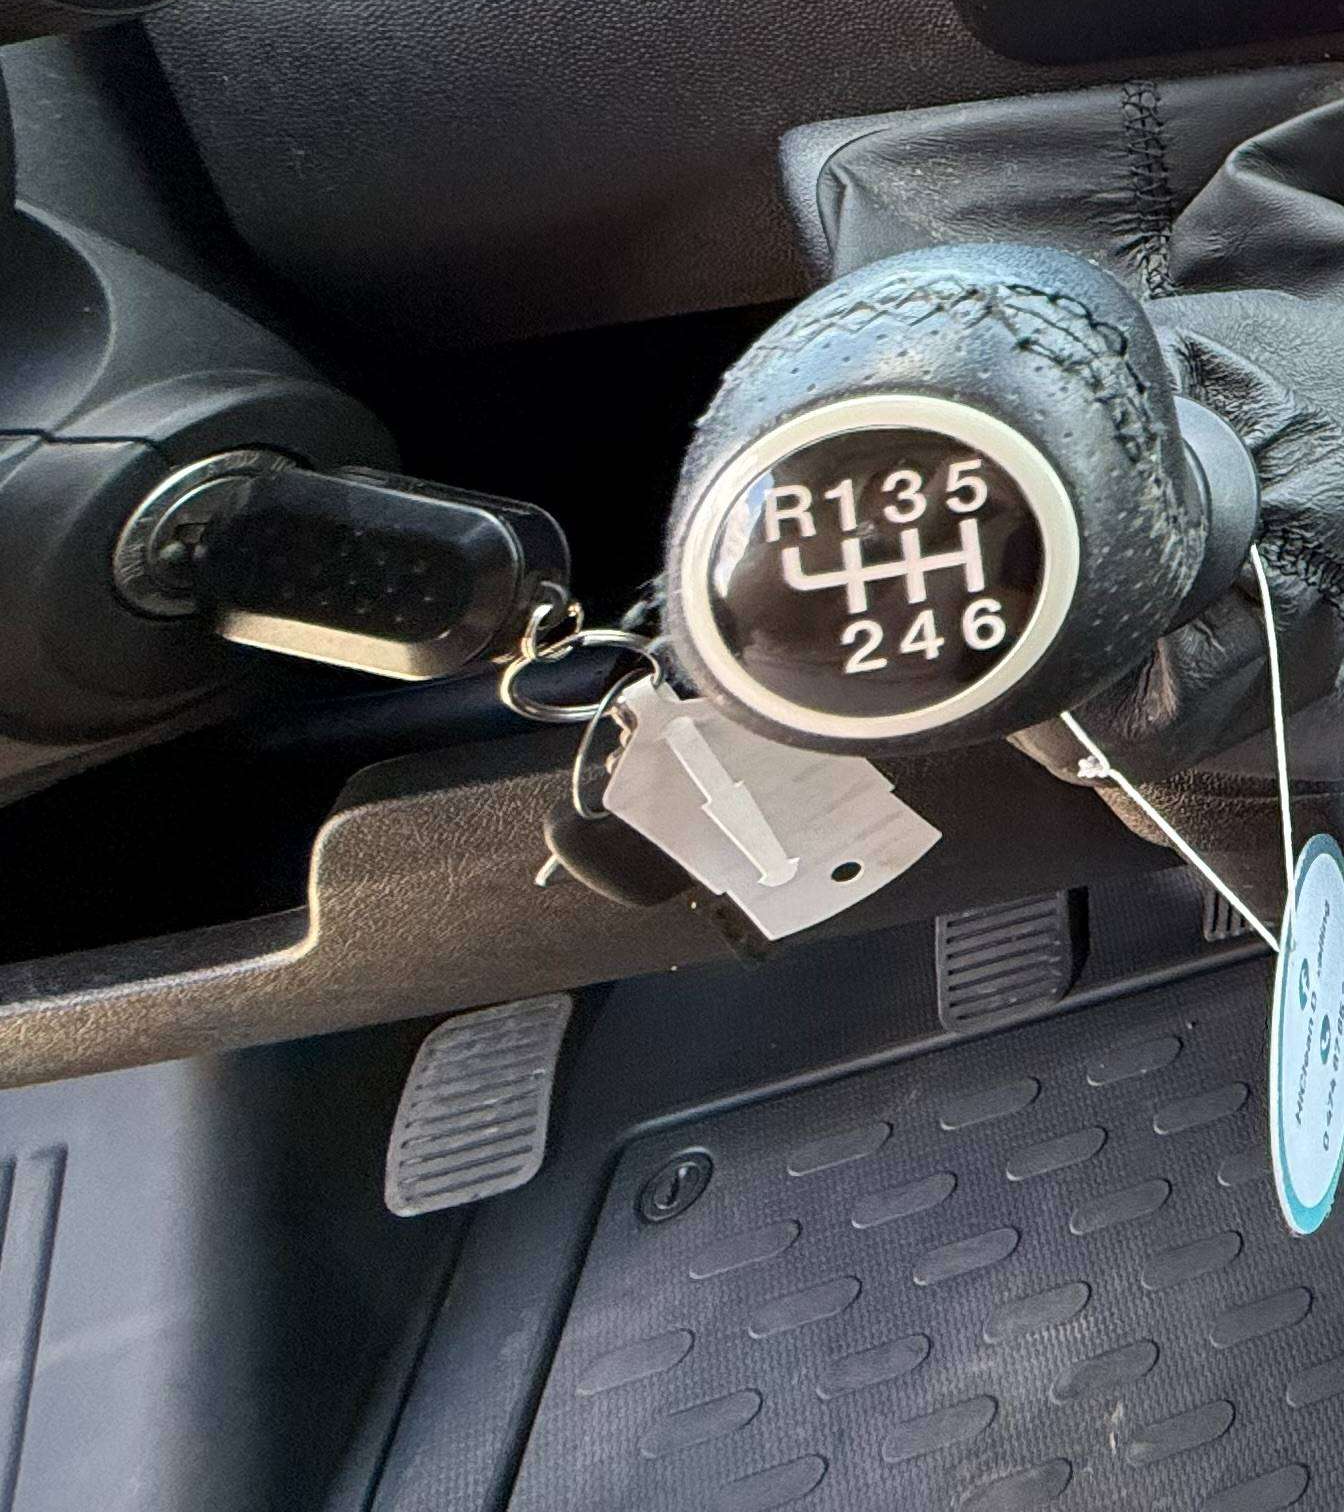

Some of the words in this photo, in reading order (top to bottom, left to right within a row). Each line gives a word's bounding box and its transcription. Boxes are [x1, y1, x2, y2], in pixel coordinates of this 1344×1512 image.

[765, 484, 817, 543] R
[823, 478, 858, 532] 1
[881, 469, 927, 524] 3
[945, 457, 989, 514] 5
[840, 619, 889, 675] 2
[900, 608, 946, 661] 4
[962, 597, 1007, 651] 6
